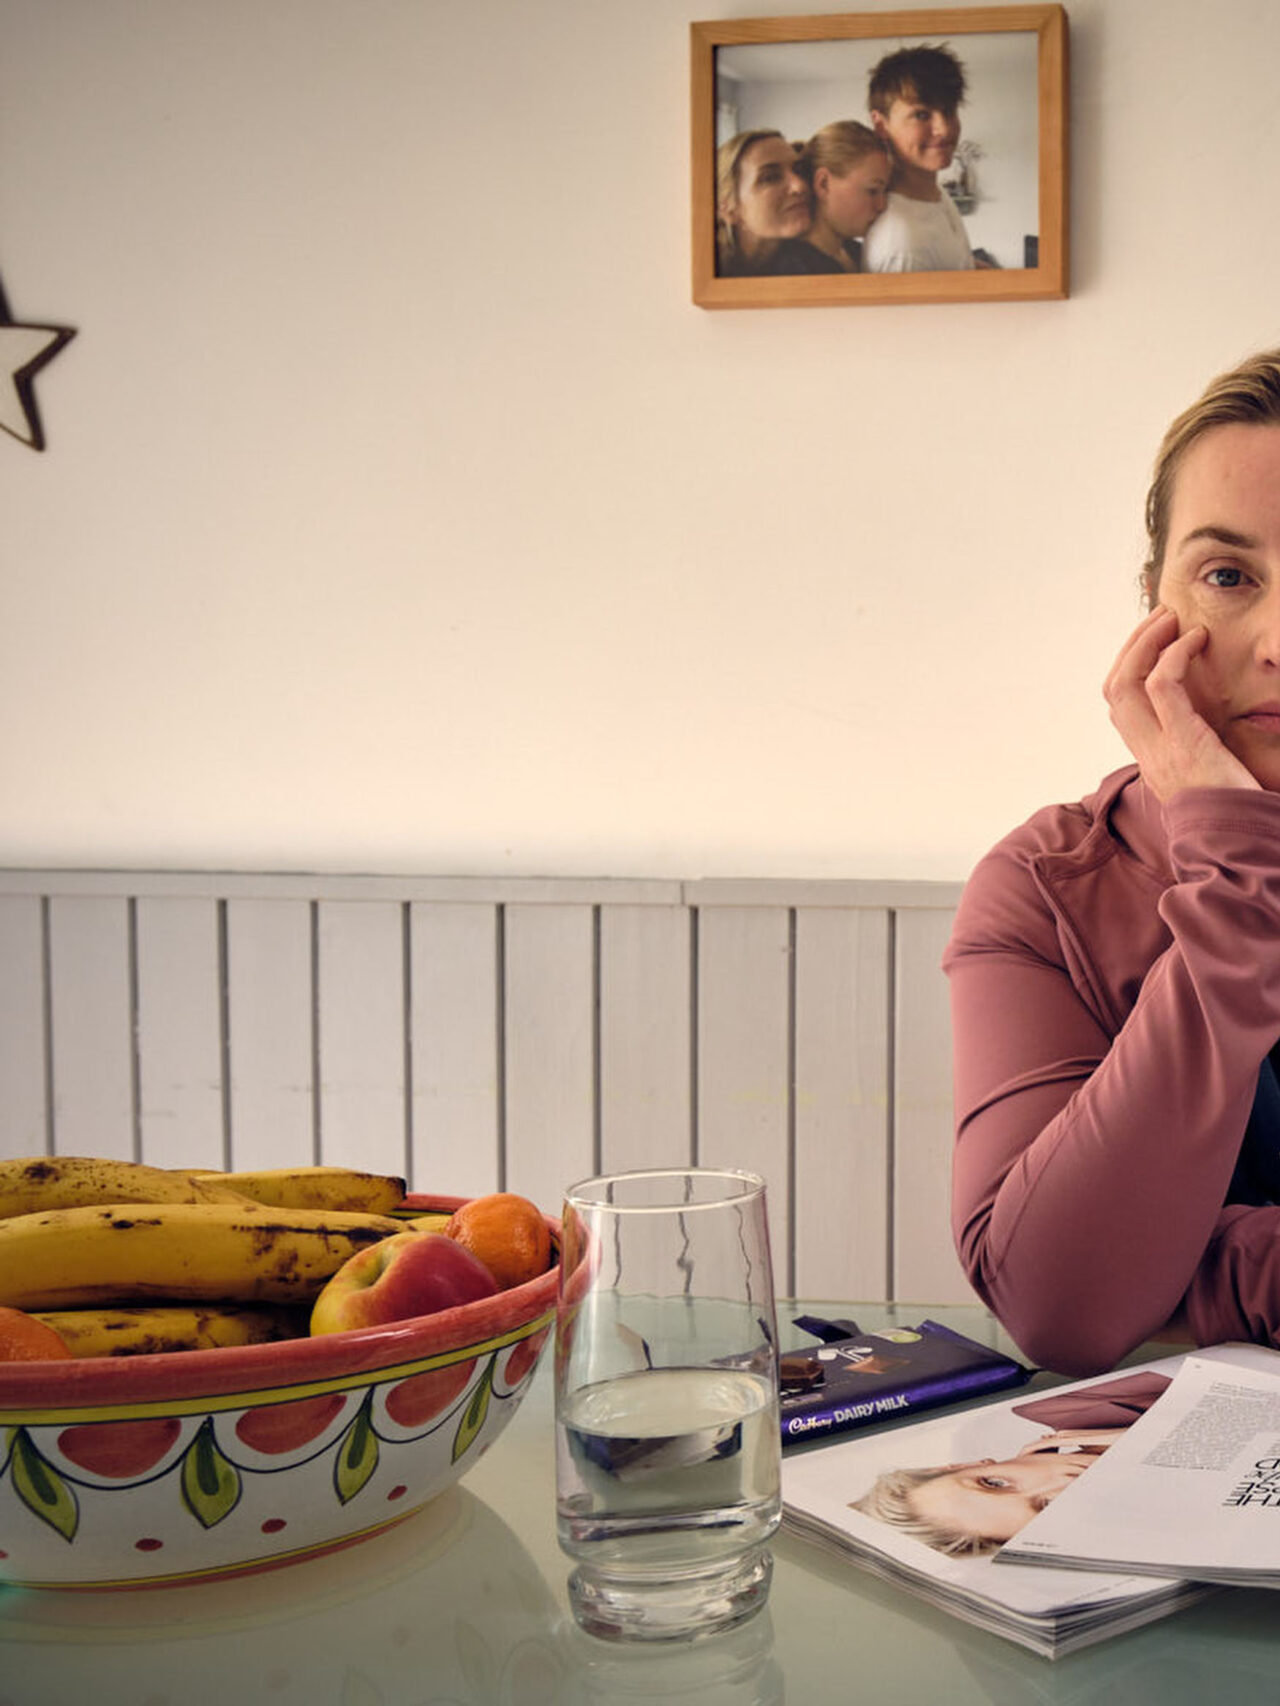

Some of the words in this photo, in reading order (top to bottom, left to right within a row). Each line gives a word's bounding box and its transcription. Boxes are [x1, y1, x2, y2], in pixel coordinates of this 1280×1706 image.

[788, 1416, 832, 1435] Cadbury
[833, 1401, 875, 1423] DAIRY
[875, 1394, 910, 1413] MILK
